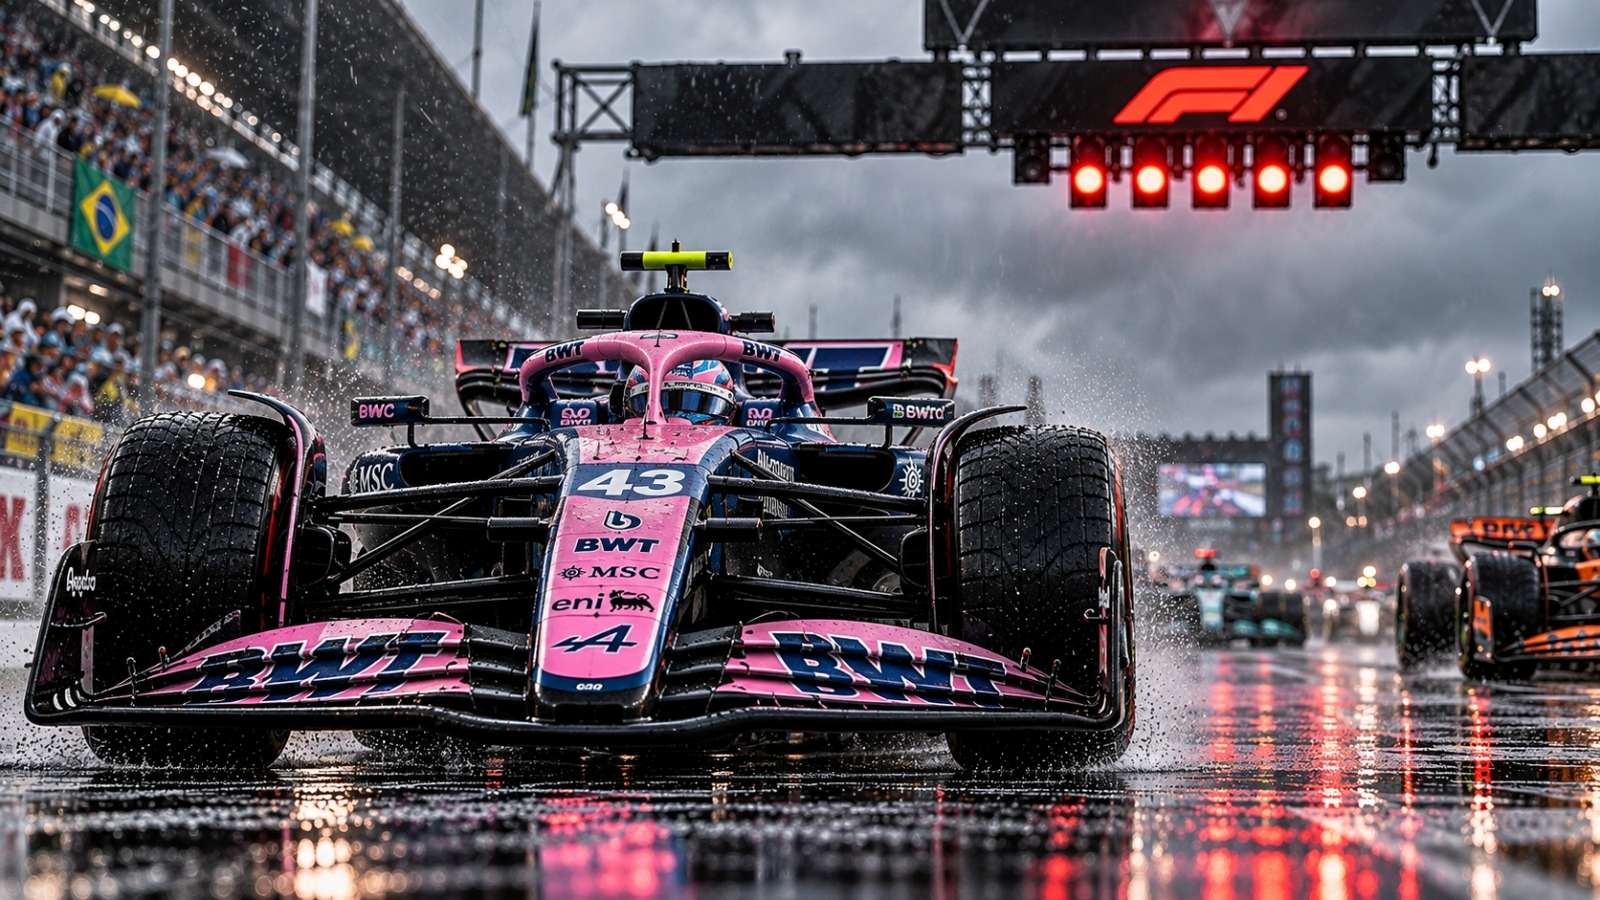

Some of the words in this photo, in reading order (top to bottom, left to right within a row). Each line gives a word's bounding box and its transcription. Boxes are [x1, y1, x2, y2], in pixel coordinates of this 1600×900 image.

[1113, 66, 1309, 123] F1
[544, 341, 584, 363] BWT
[742, 341, 781, 362] BWT
[359, 403, 395, 418] BWC
[359, 463, 394, 493] MSC
[577, 468, 684, 496] 43
[574, 537, 659, 553] BWT
[590, 566, 660, 580] MSC
[552, 593, 604, 611] eni
[183, 630, 452, 705] BWT
[768, 631, 1007, 708] BWT
